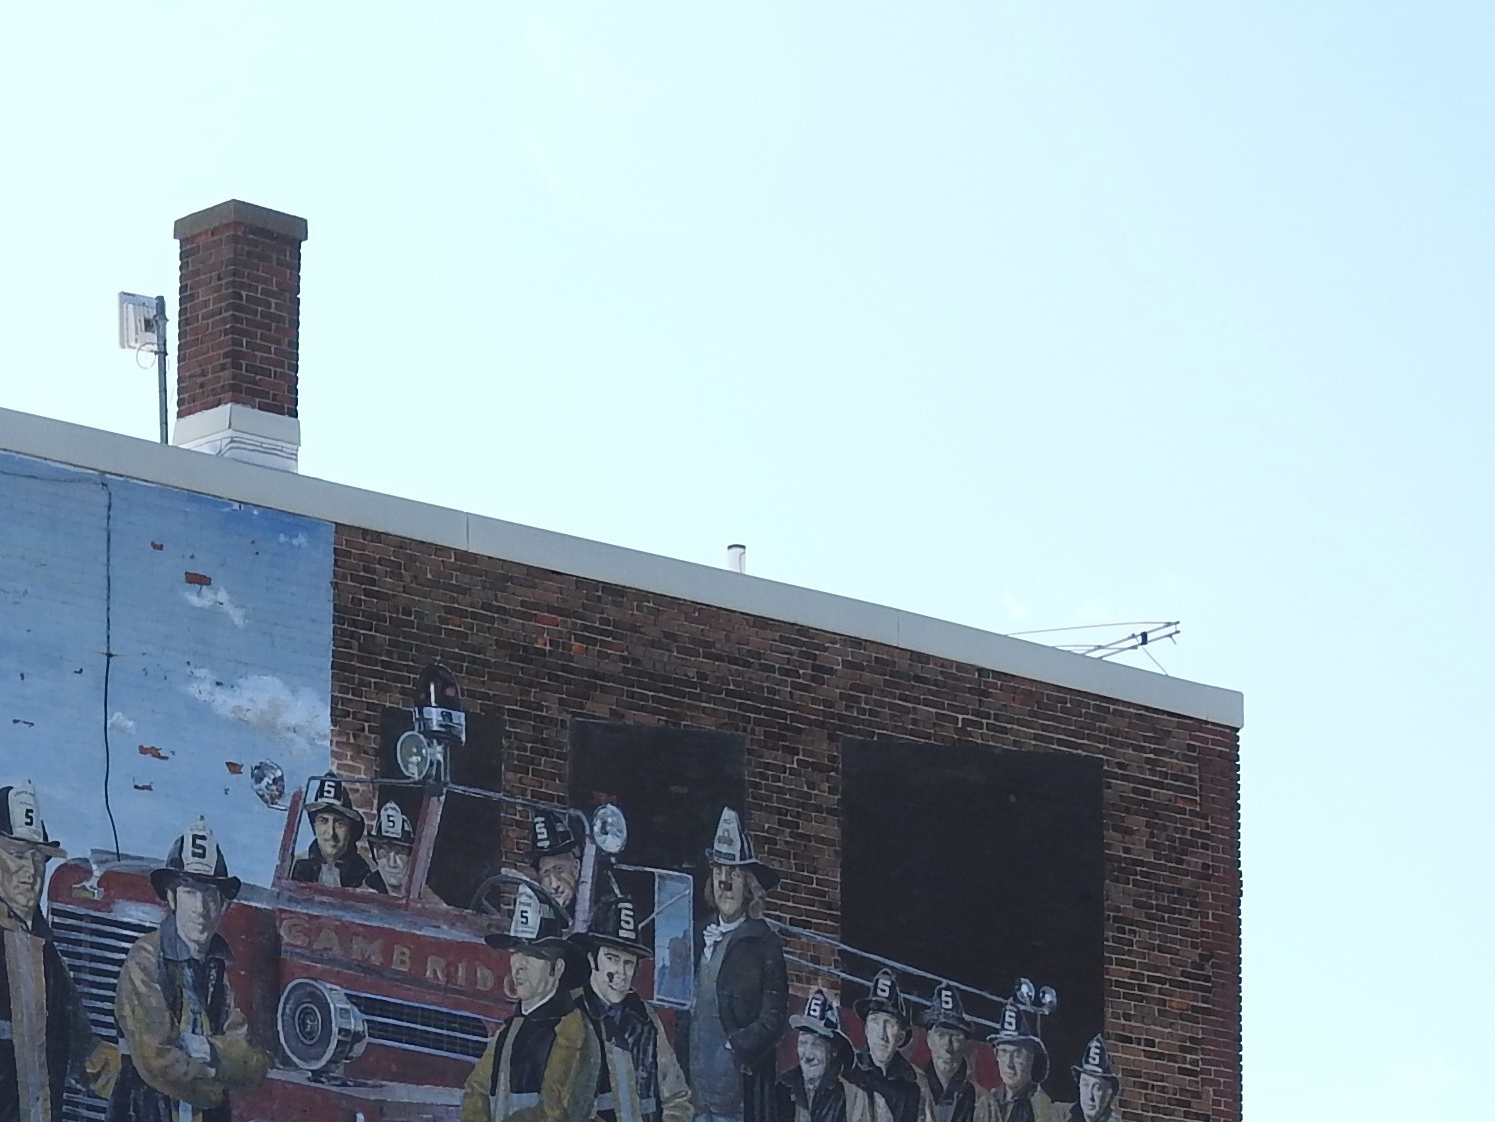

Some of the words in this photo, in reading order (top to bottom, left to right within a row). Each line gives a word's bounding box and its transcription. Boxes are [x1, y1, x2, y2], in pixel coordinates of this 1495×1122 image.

[24, 808, 34, 826] 5
[386, 814, 395, 828] 5
[520, 910, 528, 925] 5
